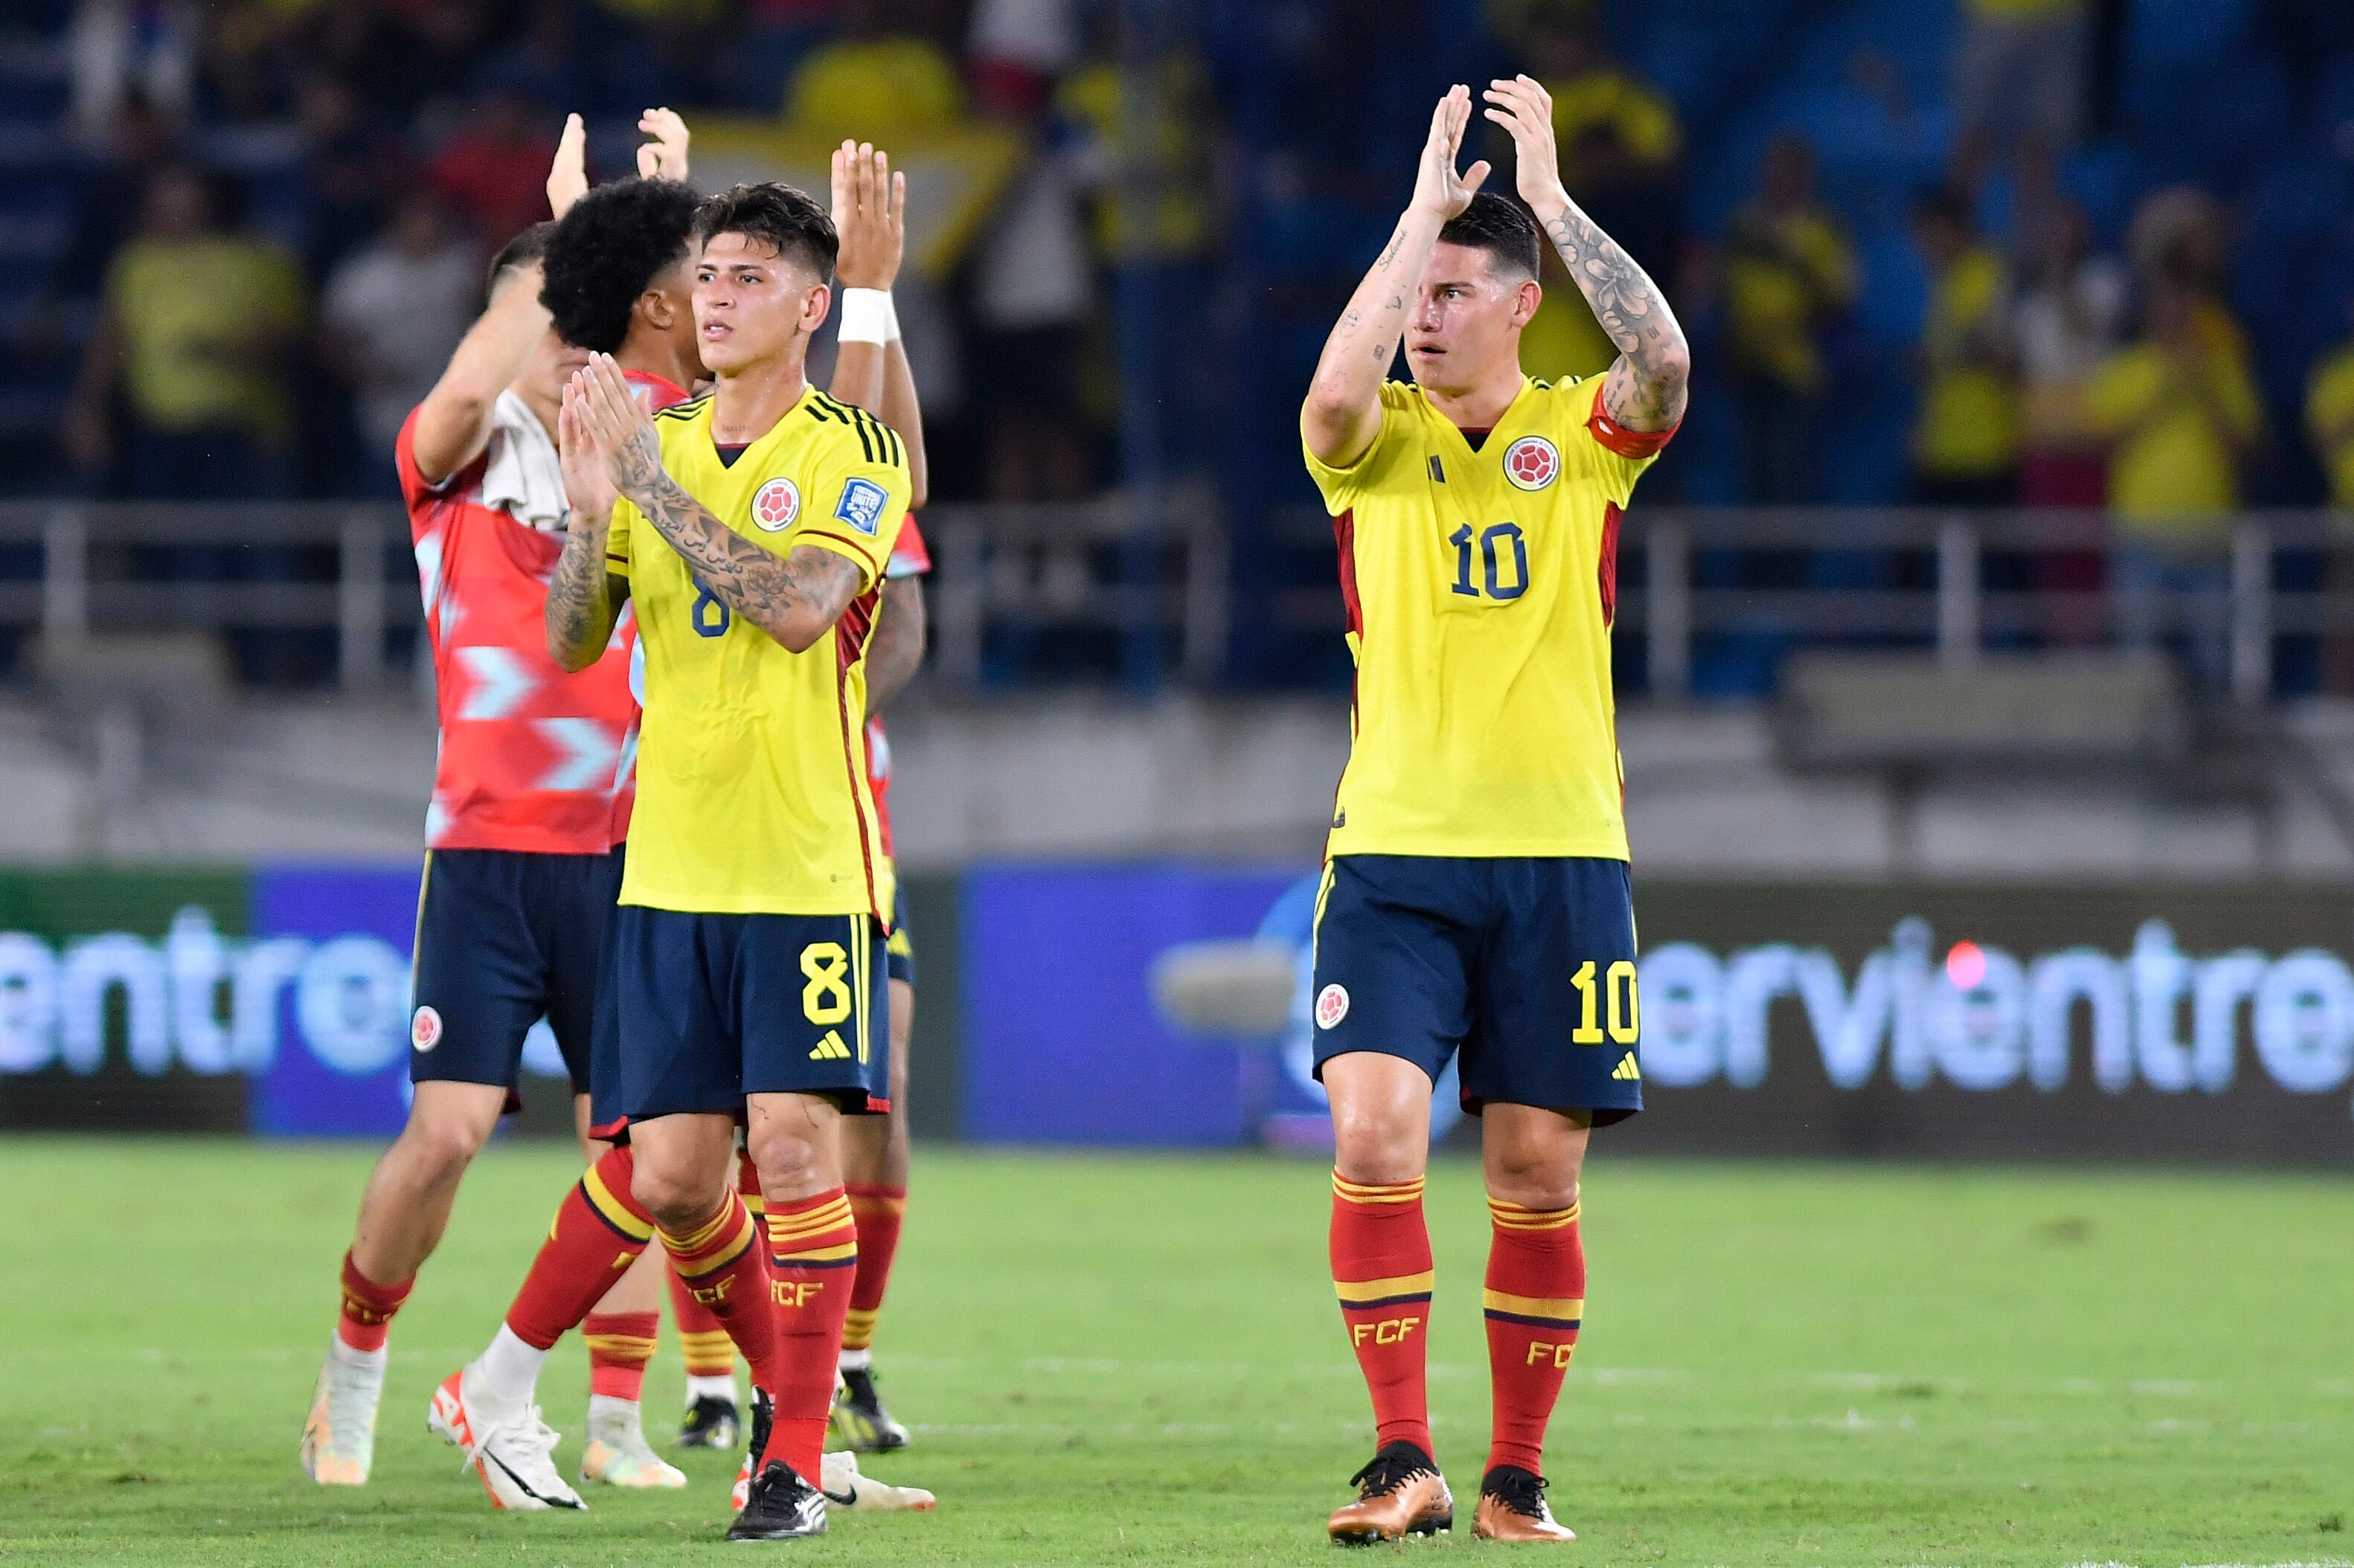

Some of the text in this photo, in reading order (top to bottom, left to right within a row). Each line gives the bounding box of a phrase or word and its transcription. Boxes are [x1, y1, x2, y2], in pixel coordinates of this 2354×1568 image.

[1448, 522, 1529, 600] 10
[691, 573, 730, 637] 8
[800, 942, 852, 1025] 8
[1570, 960, 1639, 1044] 10
[687, 1273, 736, 1305] CF
[1354, 1317, 1420, 1348] FCF
[1526, 1341, 1576, 1368] FC
